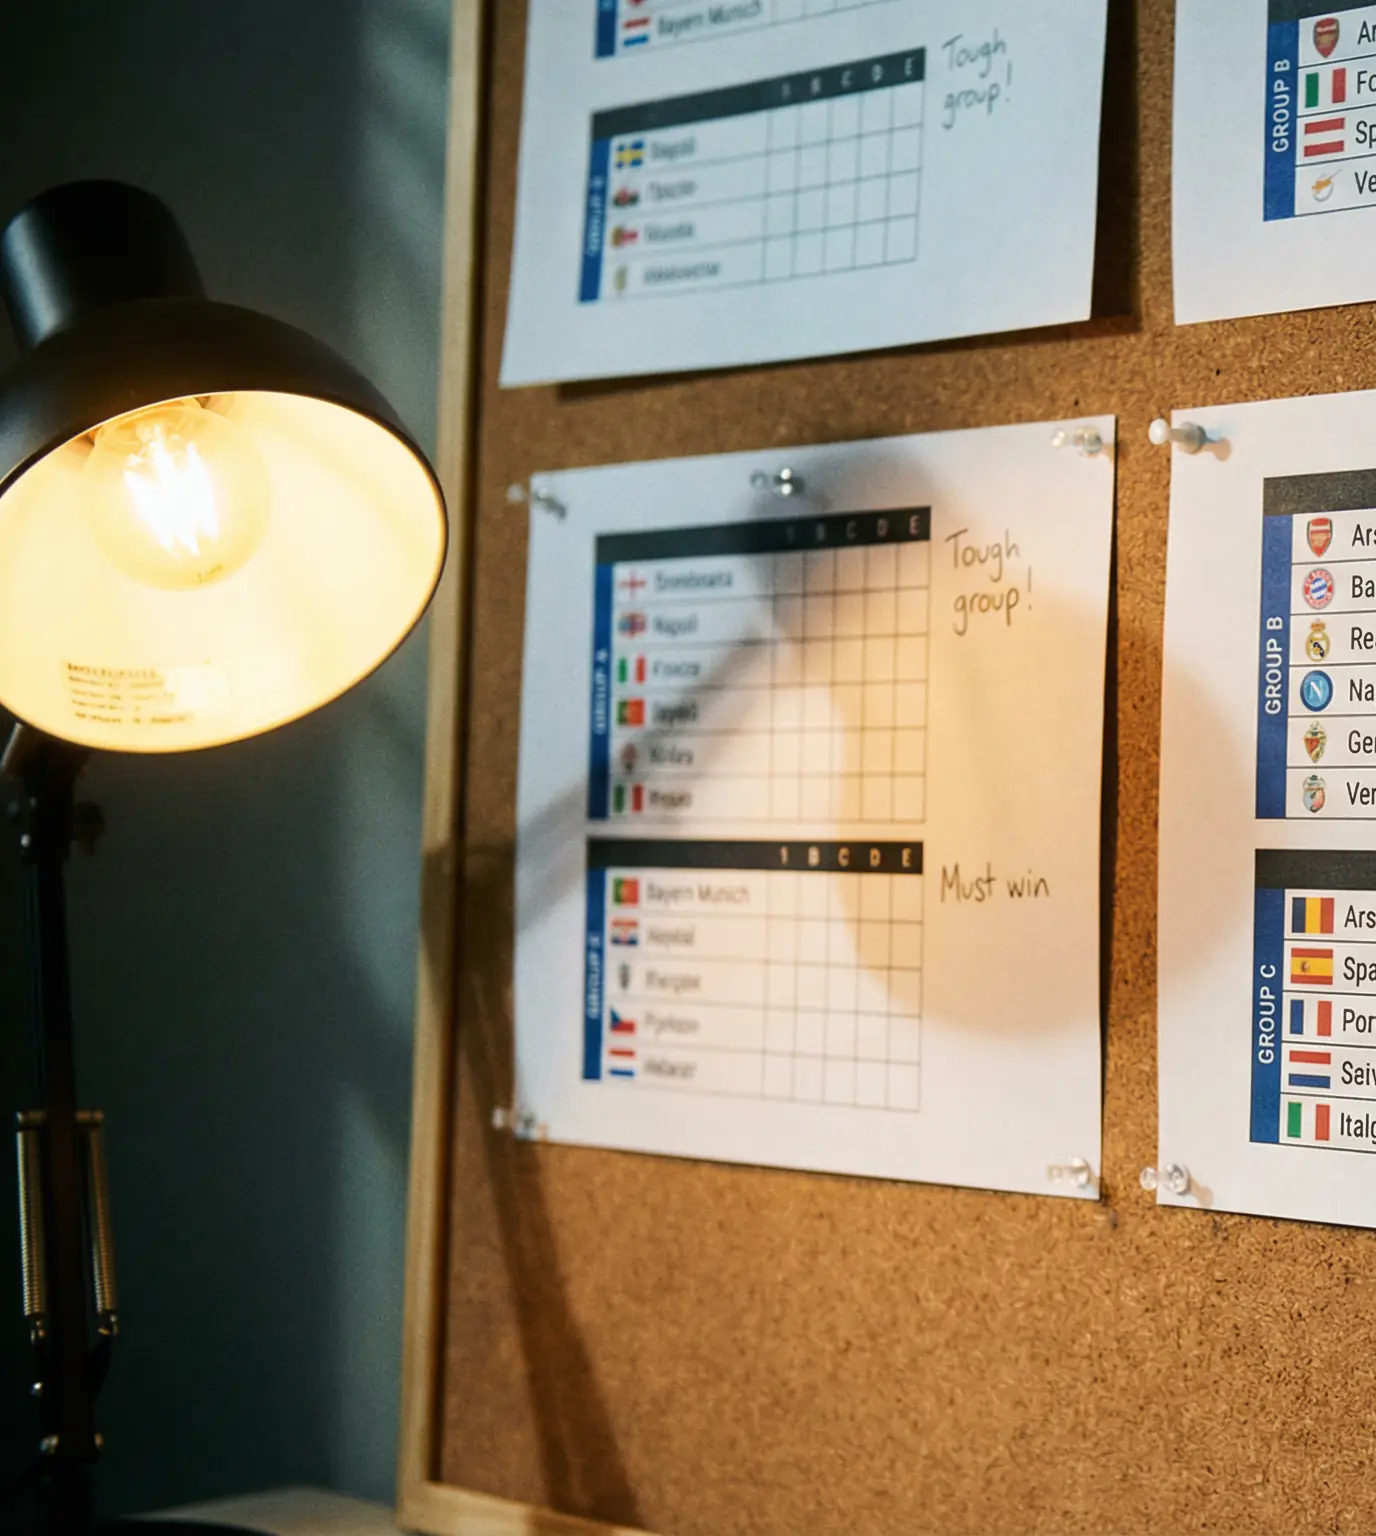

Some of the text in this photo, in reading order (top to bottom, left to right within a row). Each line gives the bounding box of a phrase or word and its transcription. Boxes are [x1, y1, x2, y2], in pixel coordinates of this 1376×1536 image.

[942, 28, 1007, 78] Tough
[1272, 60, 1291, 153] GROUP B
[945, 528, 1020, 583] Tough
[952, 564, 1032, 637] group!
[1266, 618, 1283, 715] GROUP B
[870, 847, 881, 868] D
[902, 848, 912, 868] E
[941, 862, 1050, 902] Must win
[1259, 966, 1276, 1065] GROUP C
